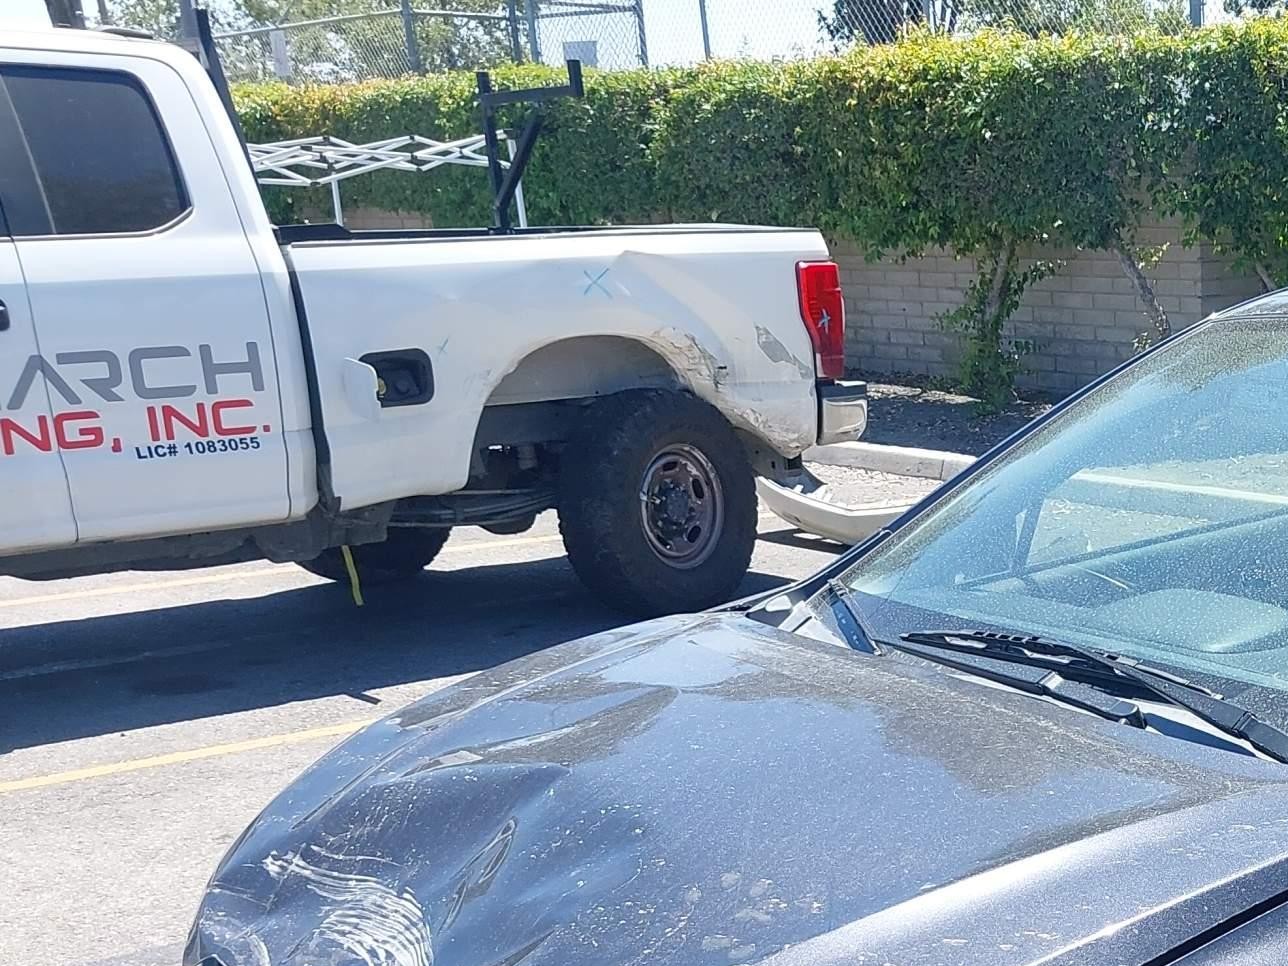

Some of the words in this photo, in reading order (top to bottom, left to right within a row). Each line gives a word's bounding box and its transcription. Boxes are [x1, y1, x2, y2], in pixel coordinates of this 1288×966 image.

[146, 399, 271, 442] INC.
[135, 443, 179, 460] LIC#
[184, 436, 261, 455] 1083055
